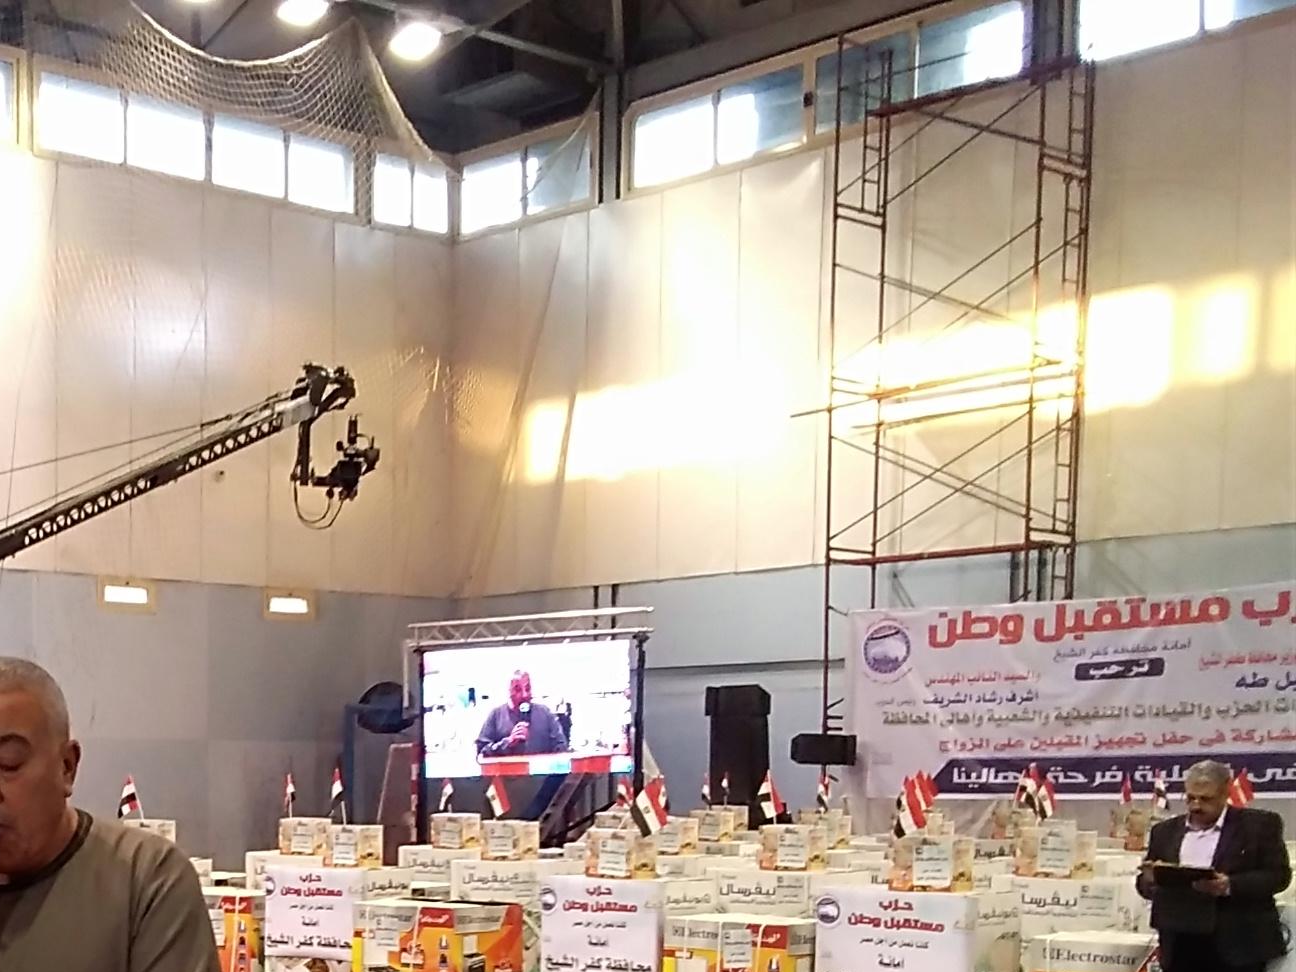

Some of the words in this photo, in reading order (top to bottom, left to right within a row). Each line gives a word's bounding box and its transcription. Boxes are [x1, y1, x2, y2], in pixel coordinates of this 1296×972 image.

[1034, 596, 1231, 642] مستقبل
[928, 610, 1025, 649] وطن
[1090, 660, 1149, 679] ترحب
[924, 672, 965, 688] المهندس
[1235, 671, 1270, 688] طه
[922, 690, 972, 708] الشريف
[975, 689, 1003, 706] رشاد
[882, 709, 936, 726] المحافظة
[987, 708, 1049, 728] والشعبية
[1054, 703, 1129, 727] التنفيذية
[1134, 700, 1211, 722] والقيادات
[1216, 700, 1269, 721] الحزب
[938, 736, 989, 753] الزواج
[1030, 734, 1089, 752] المقبلين
[1092, 731, 1147, 751] تجهيز
[1153, 730, 1194, 747] حفل
[952, 766, 1021, 789] هالينا
[1046, 764, 1124, 788] فرحة
[299, 873, 322, 883] حزب
[280, 886, 302, 896] وطن
[303, 887, 343, 897] مستقبل
[586, 885, 612, 896] حزب
[562, 900, 588, 912] وطن
[591, 901, 638, 912] مستقبل
[878, 898, 914, 912] حزب
[847, 912, 882, 928] وطن
[884, 916, 945, 933] مستقبل
[317, 935, 352, 949] حافظة
[545, 954, 579, 971] الشيخ
[581, 957, 602, 972] كفر
[605, 957, 652, 972] محافظة
[1055, 947, 1138, 966] Electrostar
